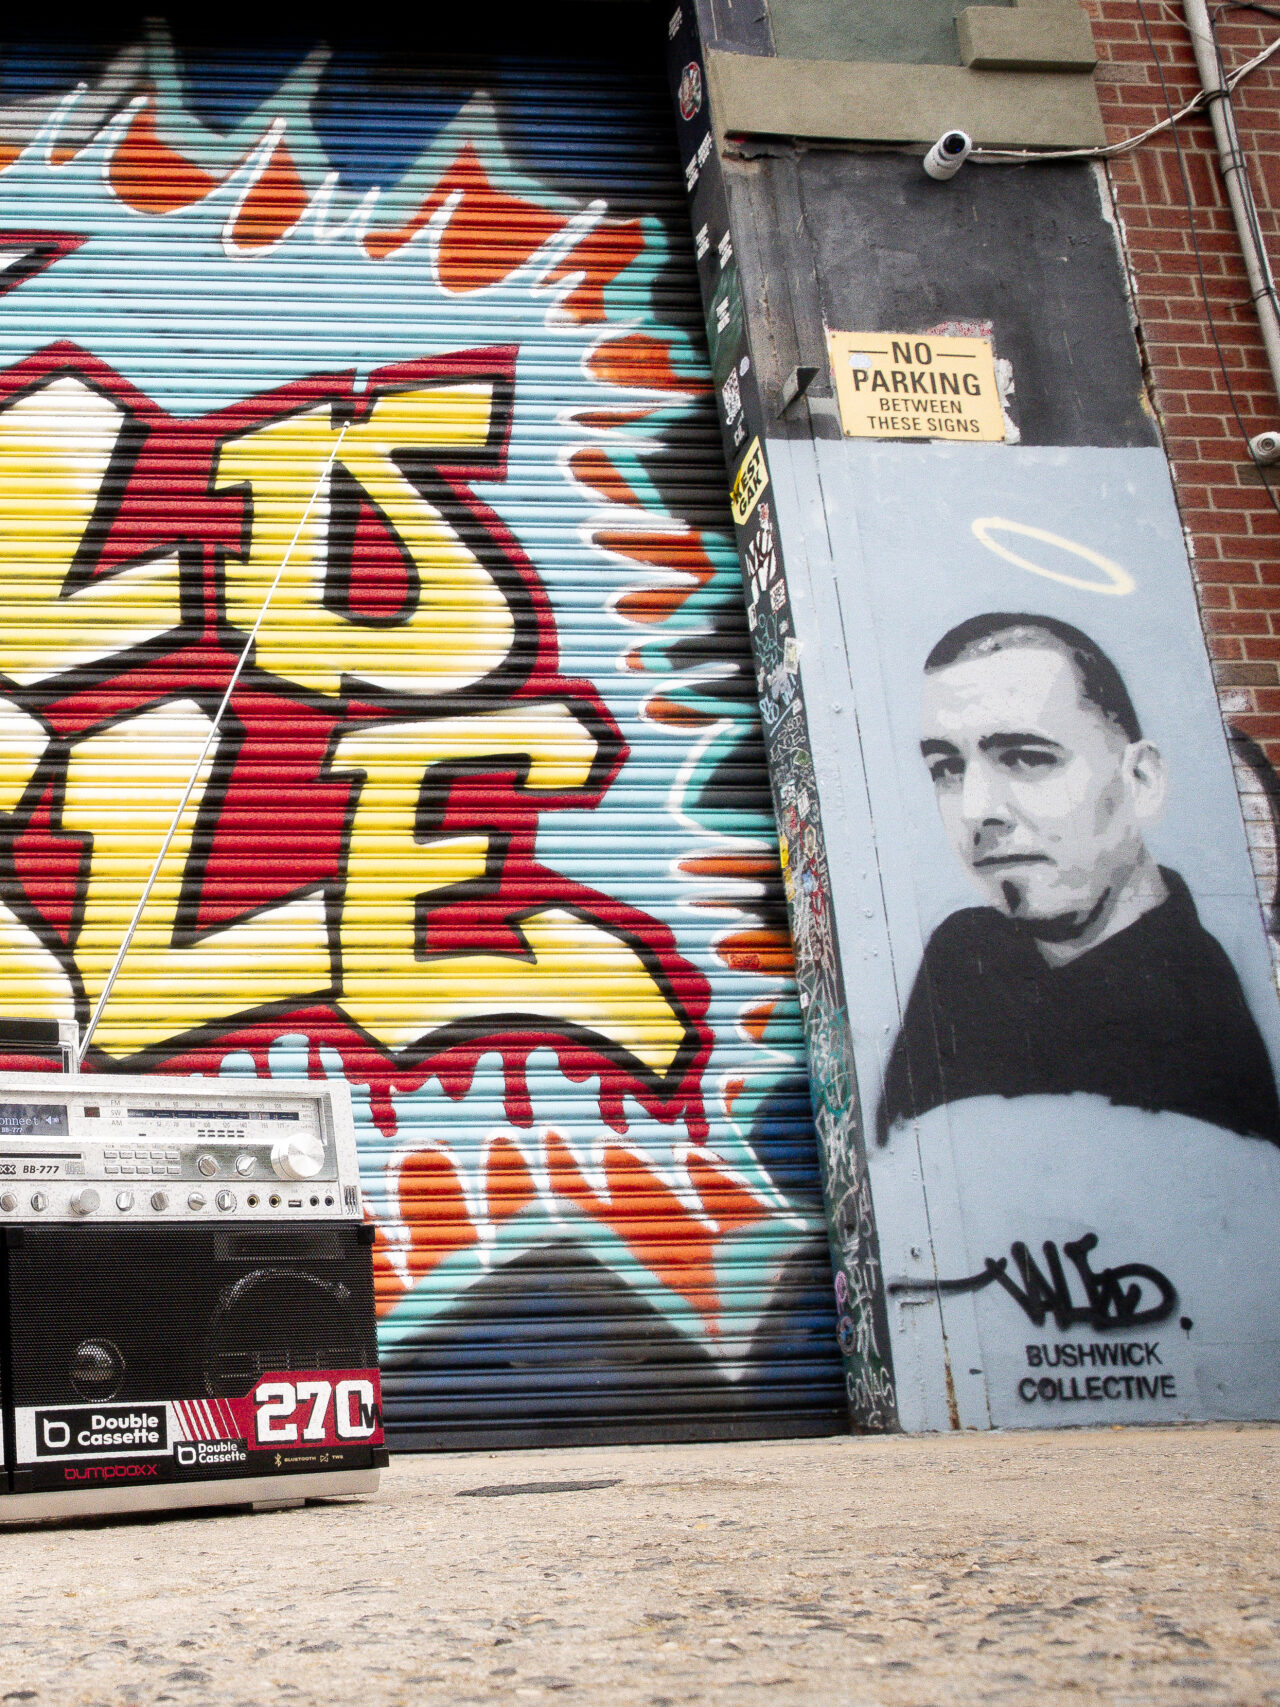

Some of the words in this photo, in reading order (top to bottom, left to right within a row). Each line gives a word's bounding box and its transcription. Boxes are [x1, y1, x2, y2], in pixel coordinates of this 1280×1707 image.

[892, 342, 933, 365] NO
[853, 369, 982, 396] PARKING
[880, 398, 963, 414] BETWEEN
[867, 416, 922, 431] THESE
[927, 418, 980, 433] SIGNS
[23, 1165, 60, 1174] BB-777
[1025, 1342, 1164, 1368] BUSHWICK
[1019, 1375, 1178, 1401] COLLECTIVE
[91, 1413, 160, 1431] Double
[77, 1429, 160, 1446] Cassette
[198, 1442, 238, 1453] Double
[198, 1451, 247, 1464] Cassette
[64, 1463, 158, 1481] bumpboxx
